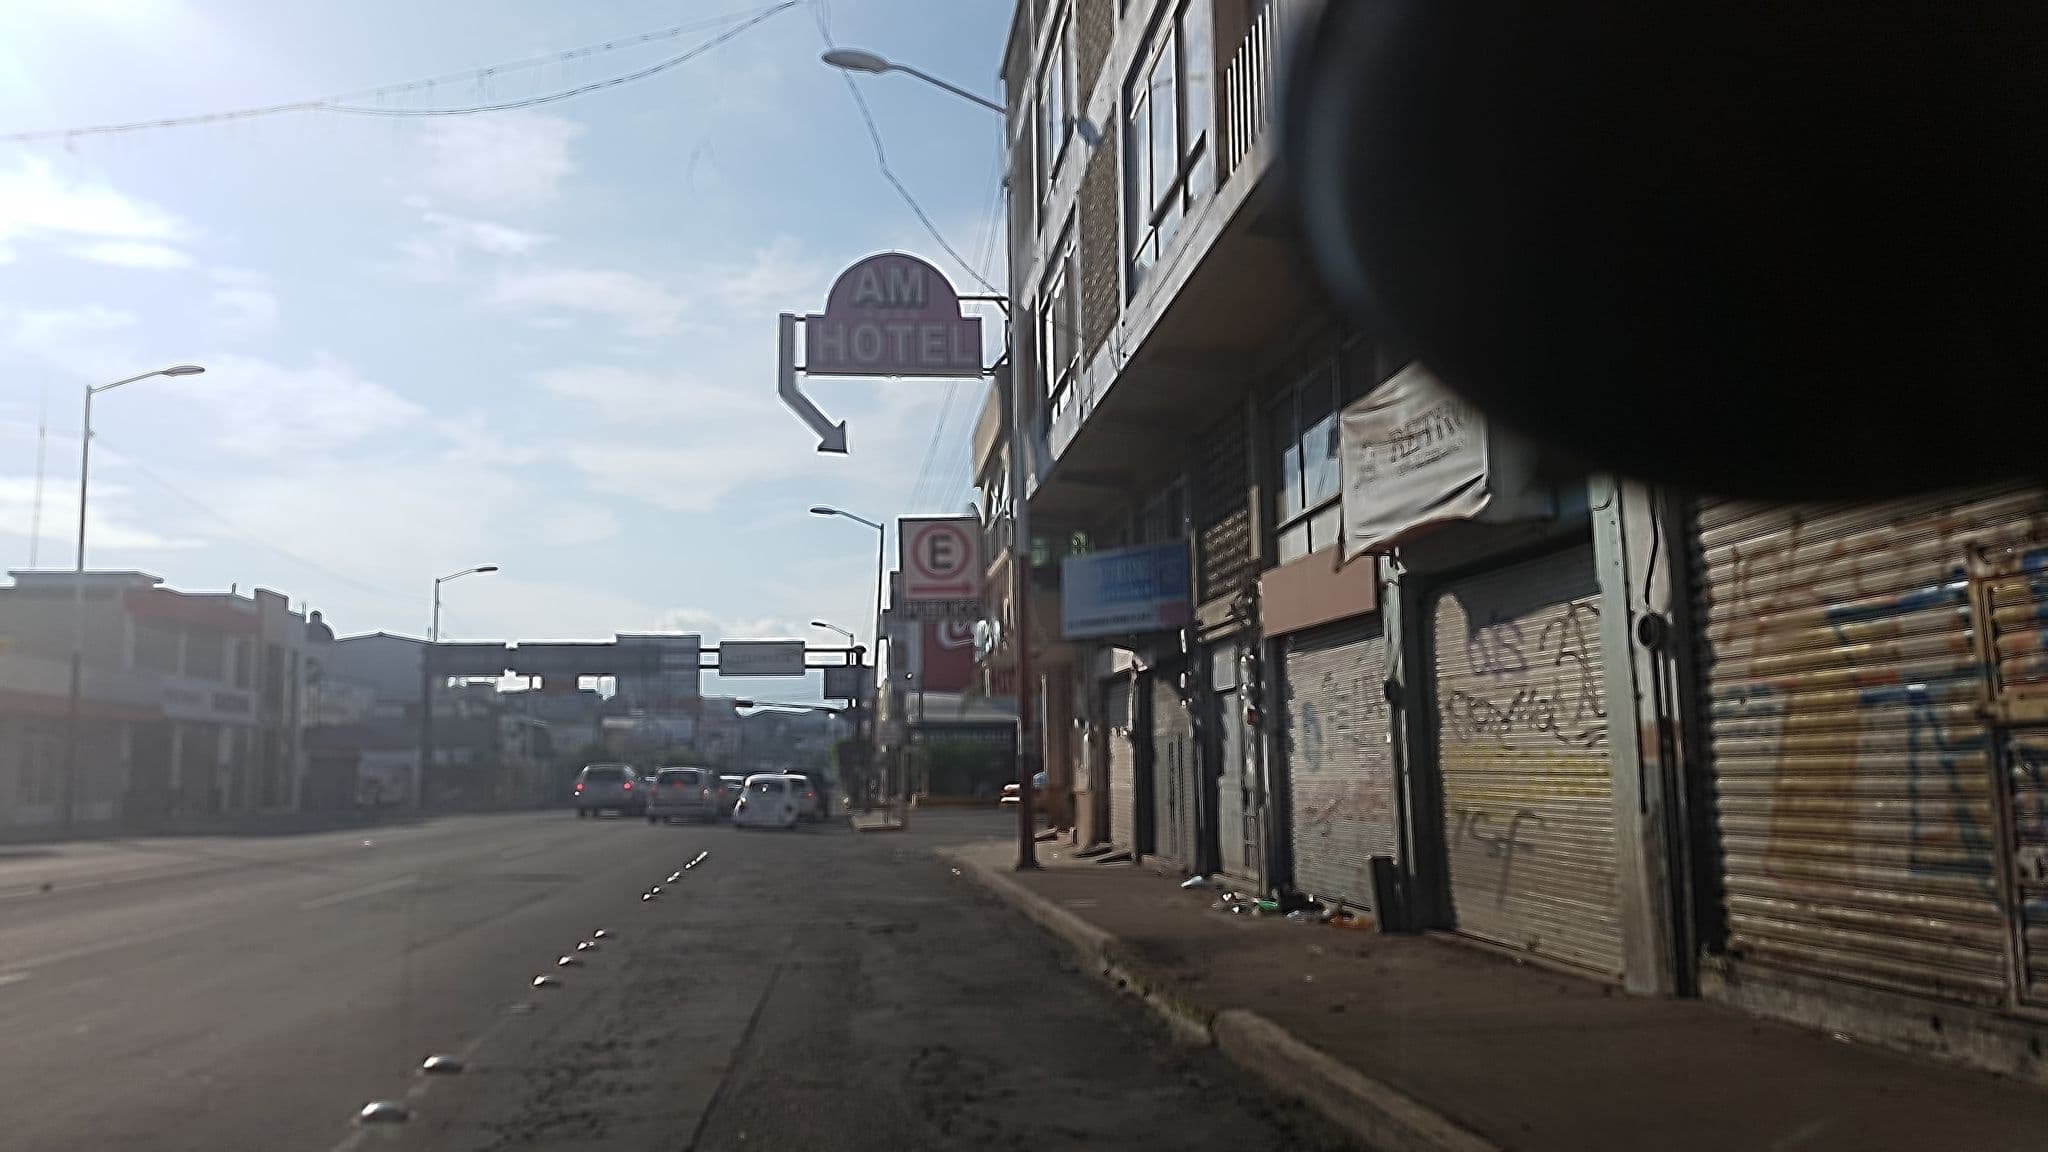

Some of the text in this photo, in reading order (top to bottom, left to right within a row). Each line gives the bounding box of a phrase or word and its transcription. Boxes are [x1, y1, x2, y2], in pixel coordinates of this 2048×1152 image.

[854, 266, 925, 305] AM
[816, 323, 975, 366] HOTEL
[928, 534, 953, 570] E
